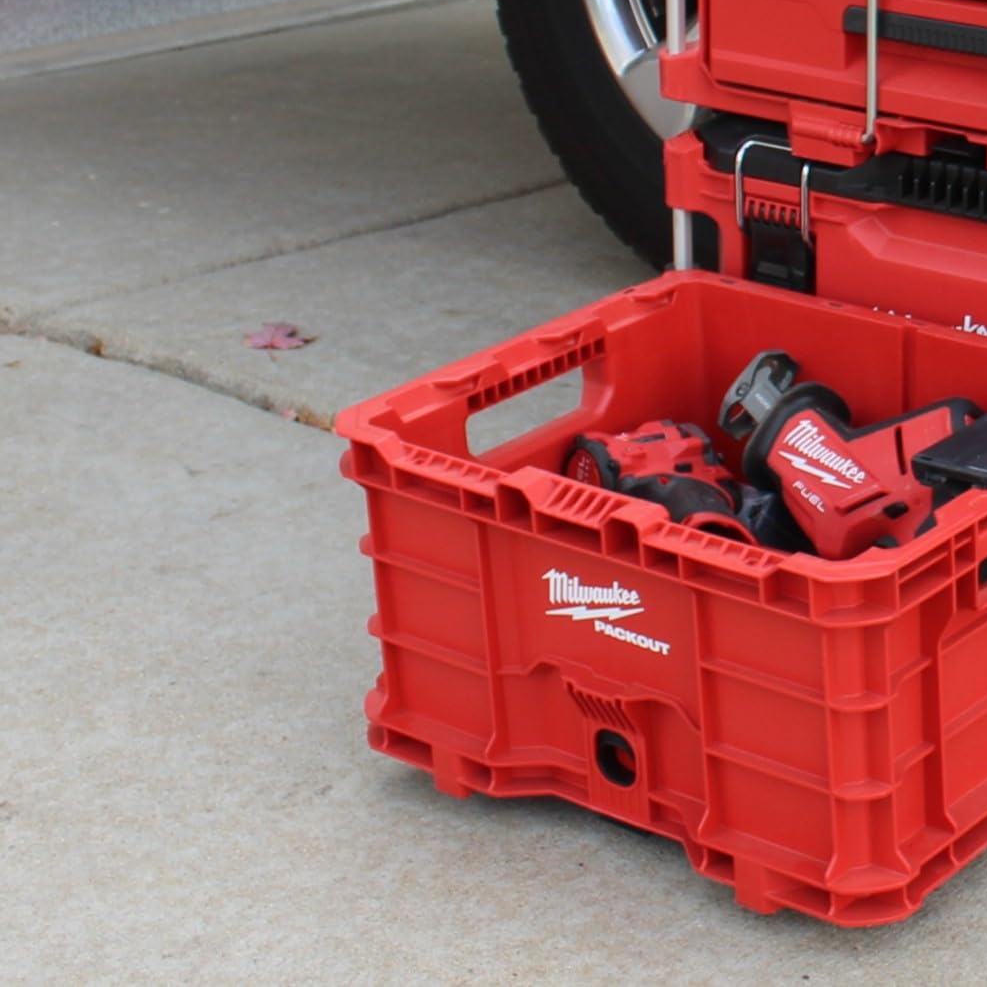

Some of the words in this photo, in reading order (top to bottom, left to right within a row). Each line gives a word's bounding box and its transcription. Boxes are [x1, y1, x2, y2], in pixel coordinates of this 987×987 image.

[783, 419, 866, 484] Milwaukee
[792, 480, 825, 513] FUEL
[541, 568, 641, 605] Milwaukee
[594, 619, 670, 656] PACKOUT
